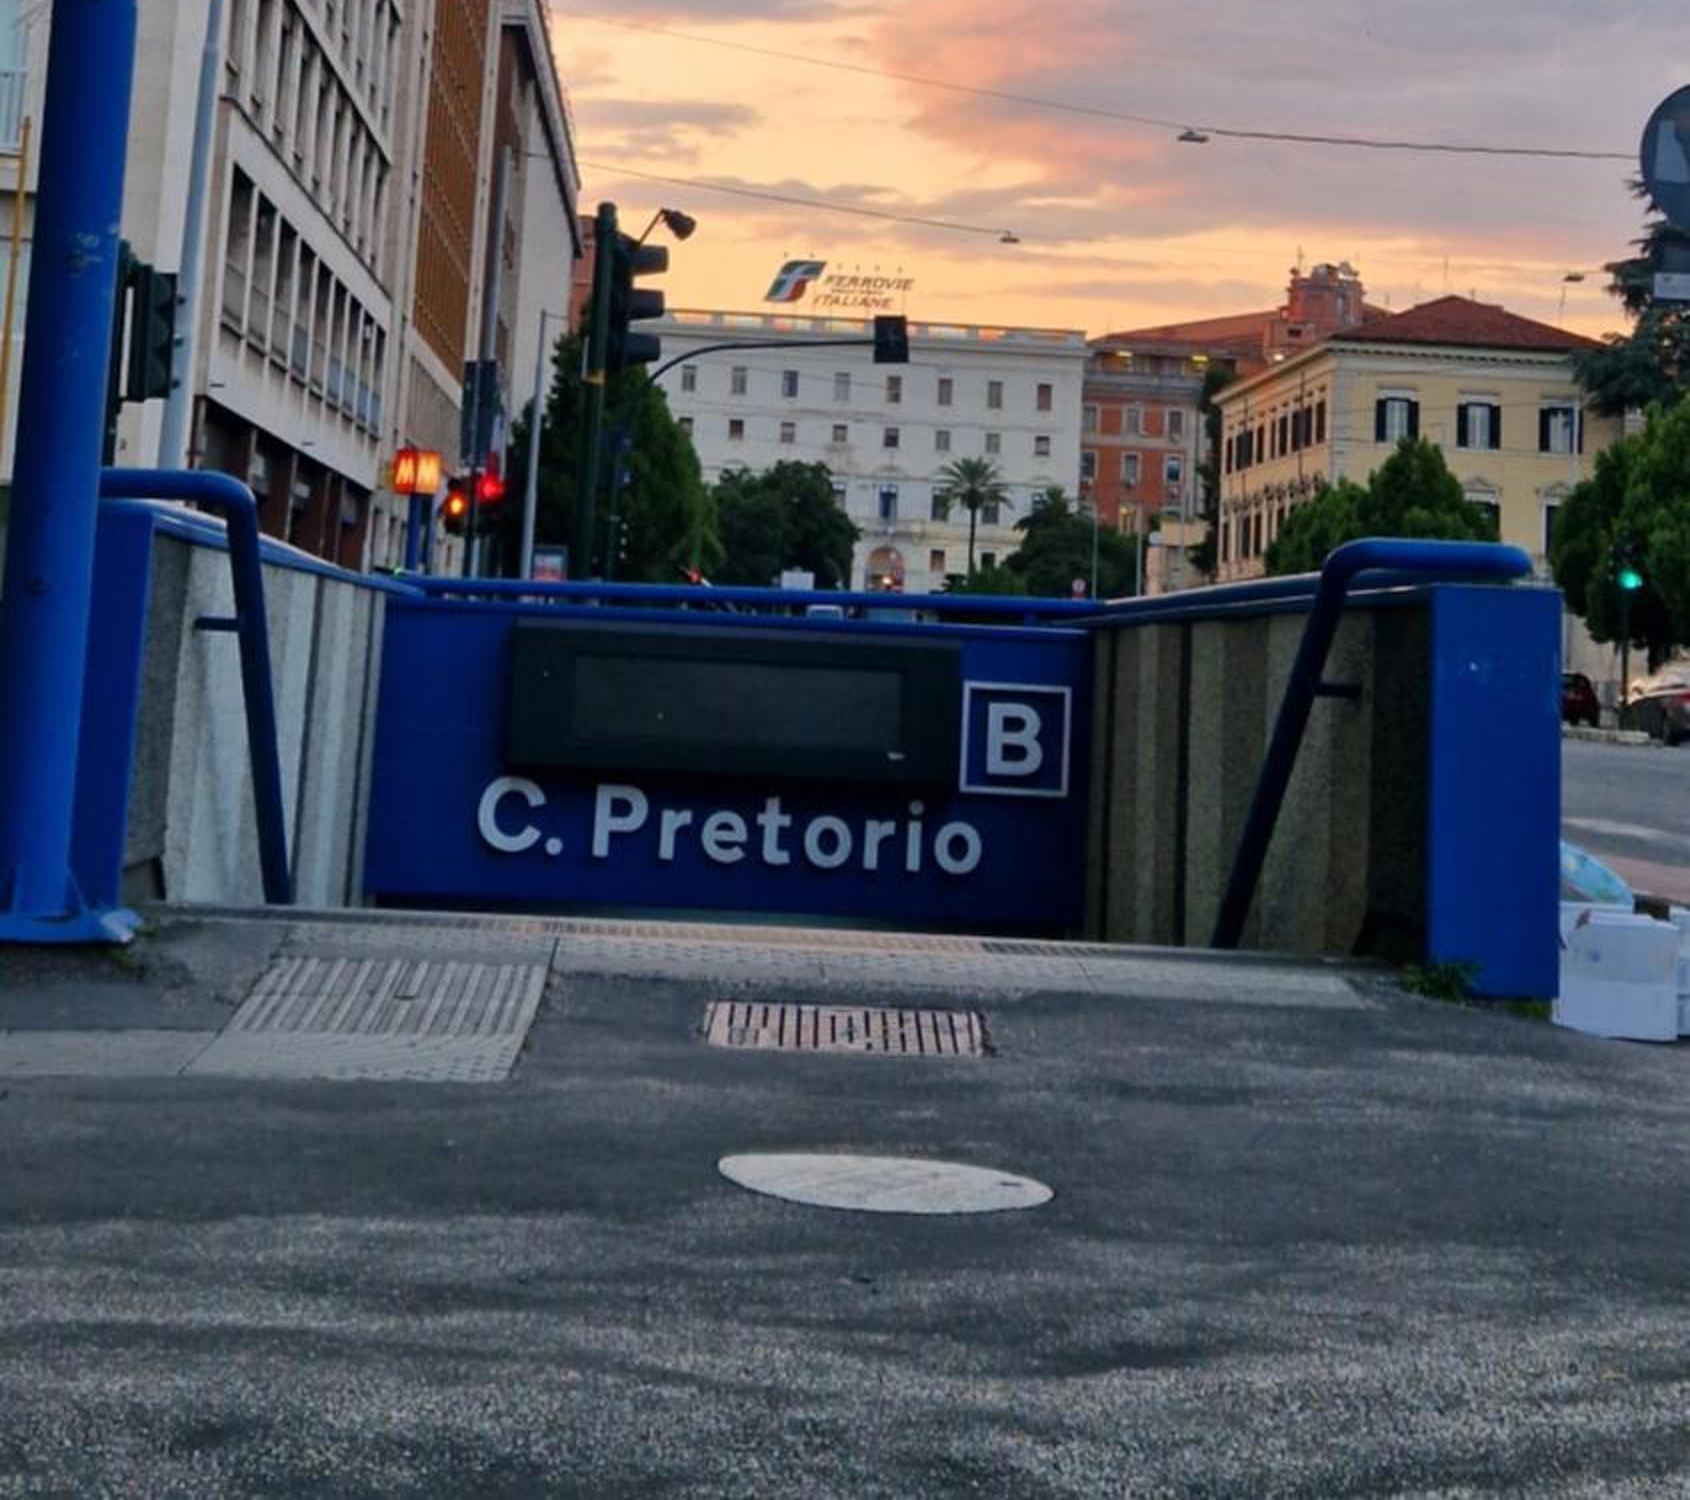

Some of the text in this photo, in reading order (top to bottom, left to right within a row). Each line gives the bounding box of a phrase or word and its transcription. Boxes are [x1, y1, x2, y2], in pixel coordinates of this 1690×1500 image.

[812, 293, 894, 309] ITALIANE
[824, 274, 916, 292] FERROVIE
[986, 702, 1044, 776] B
[477, 776, 983, 875] C. Pretorio
